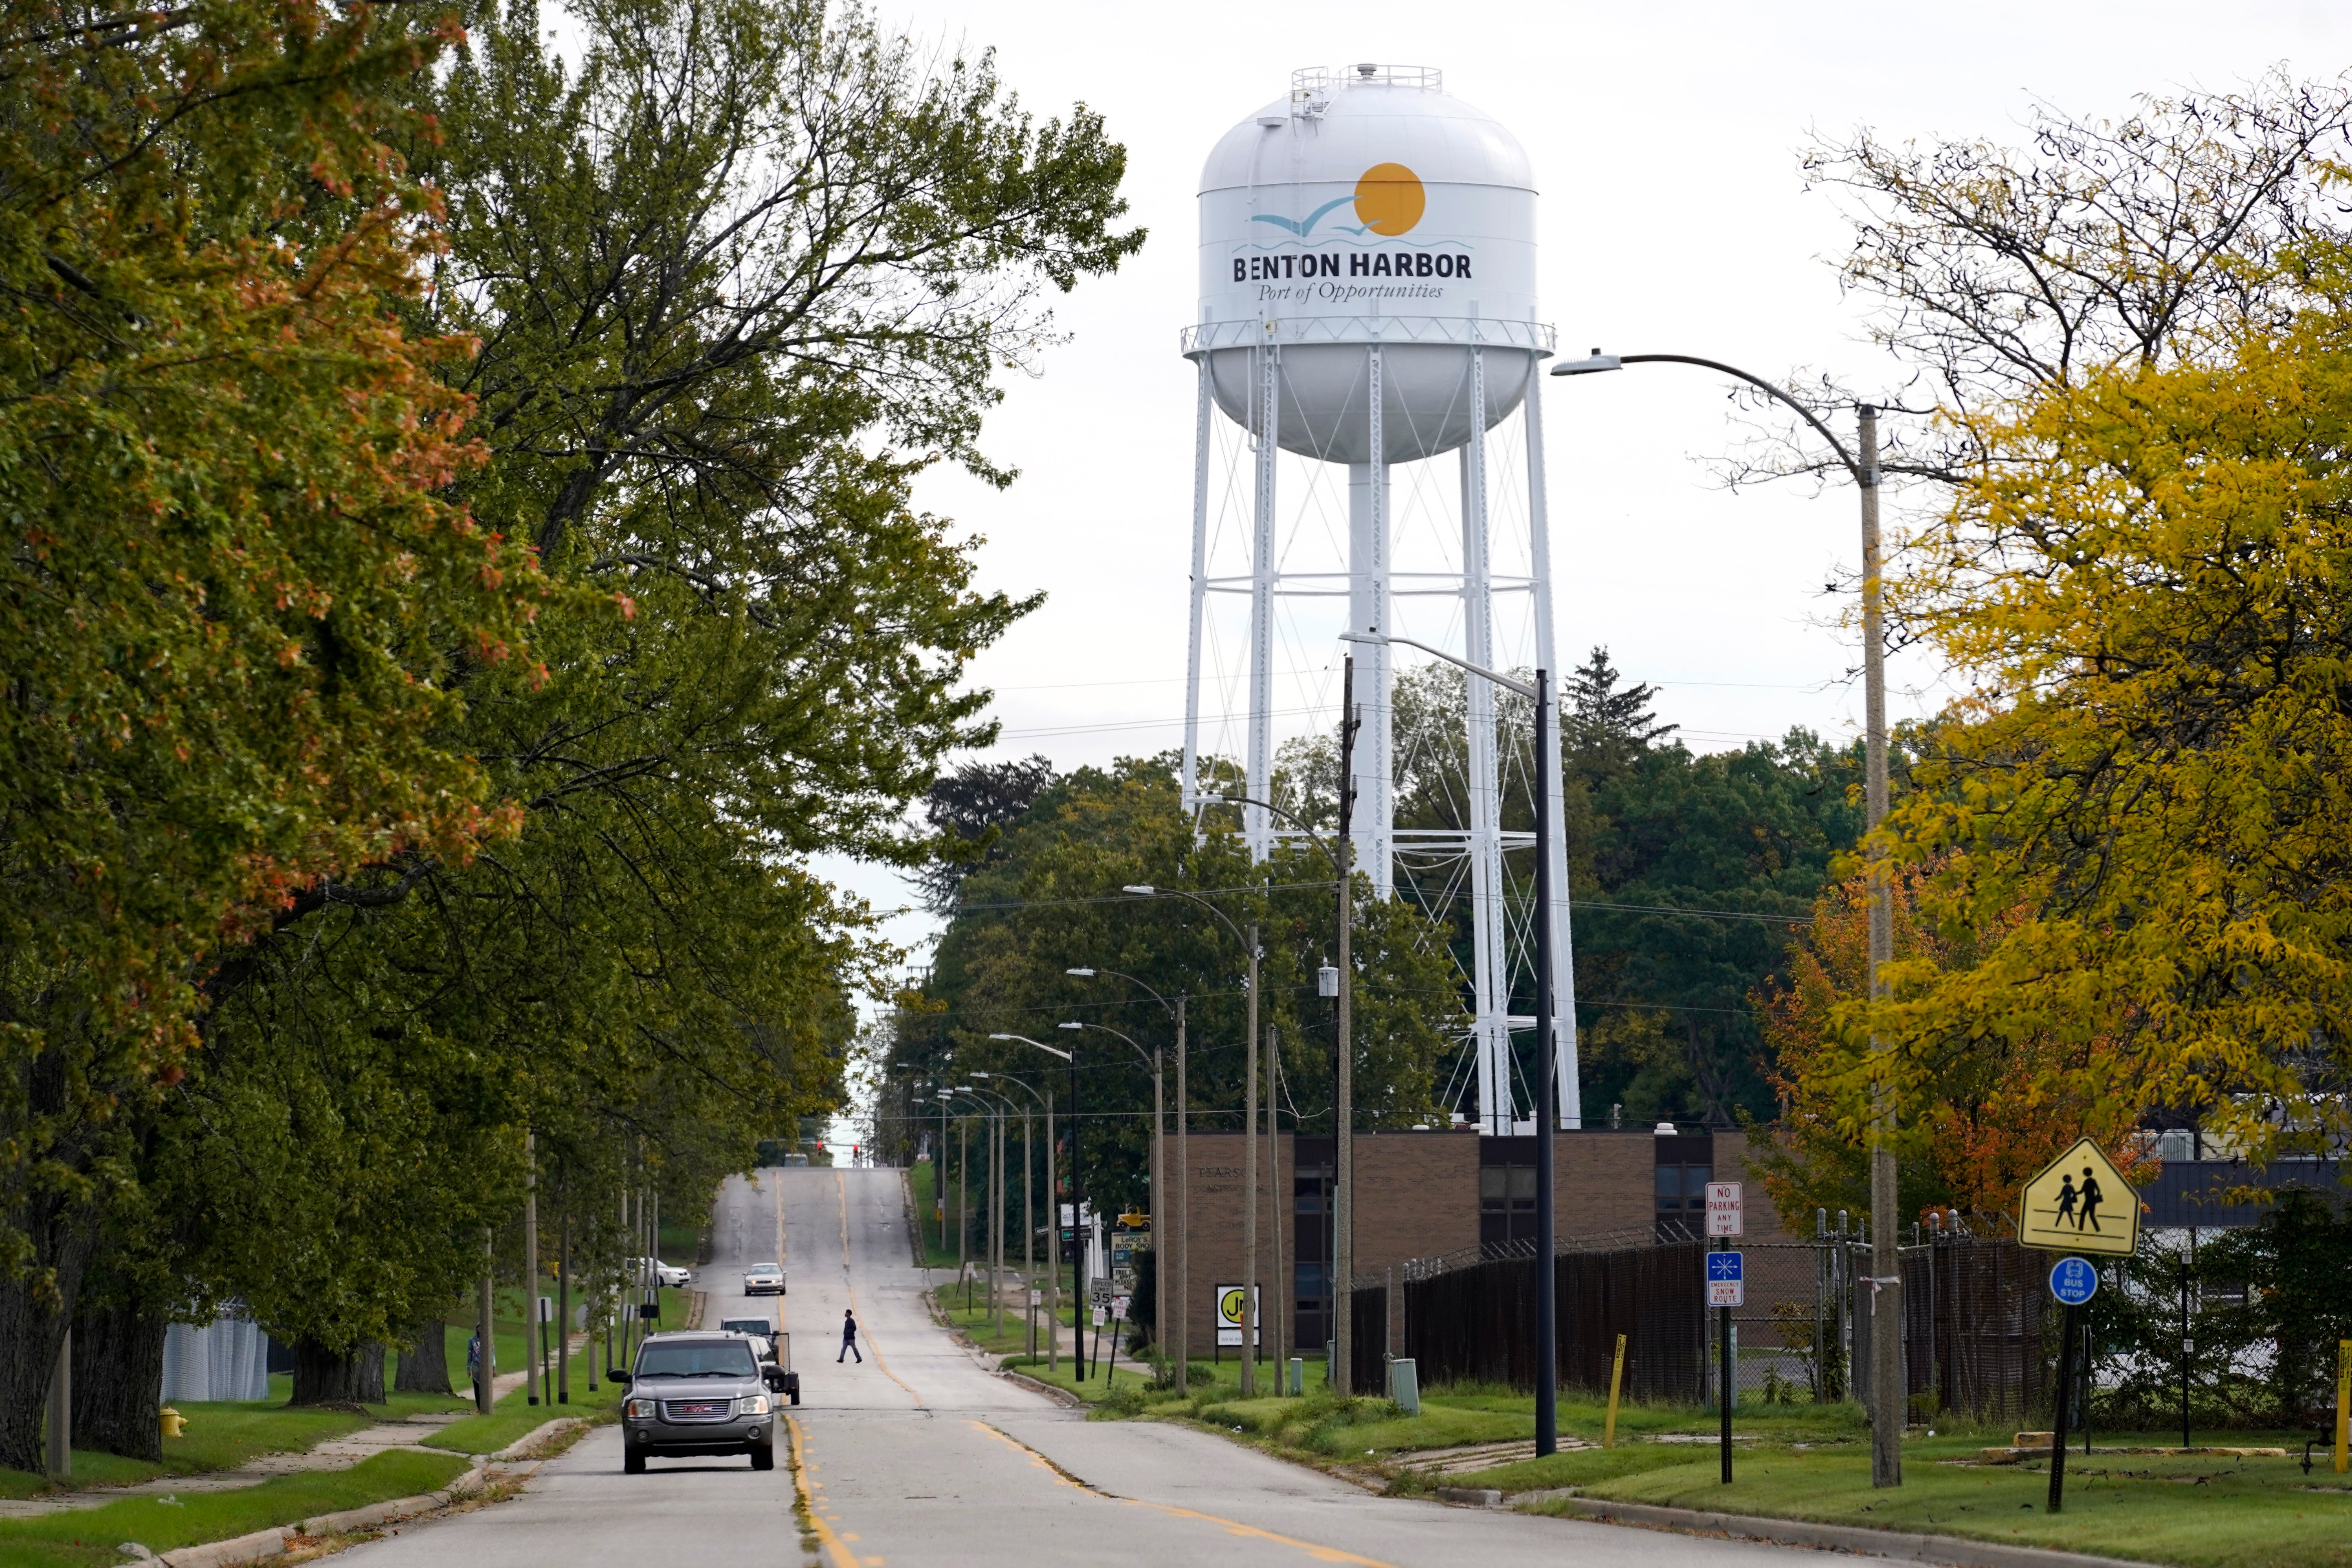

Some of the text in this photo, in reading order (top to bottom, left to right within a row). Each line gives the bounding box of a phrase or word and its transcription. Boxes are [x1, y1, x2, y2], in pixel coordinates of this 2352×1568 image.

[1233, 253, 1472, 282] BENTON HARBOR
[1259, 281, 1444, 304] Port of Opportunities
[1199, 1167, 1259, 1177] PEARSO
[1717, 1188, 1730, 1198] NO
[1709, 1201, 1739, 1211] PARKING
[2064, 1278, 2084, 1287] BUS
[1092, 1292, 1110, 1303] 35
[2061, 1289, 2085, 1298] STOP
